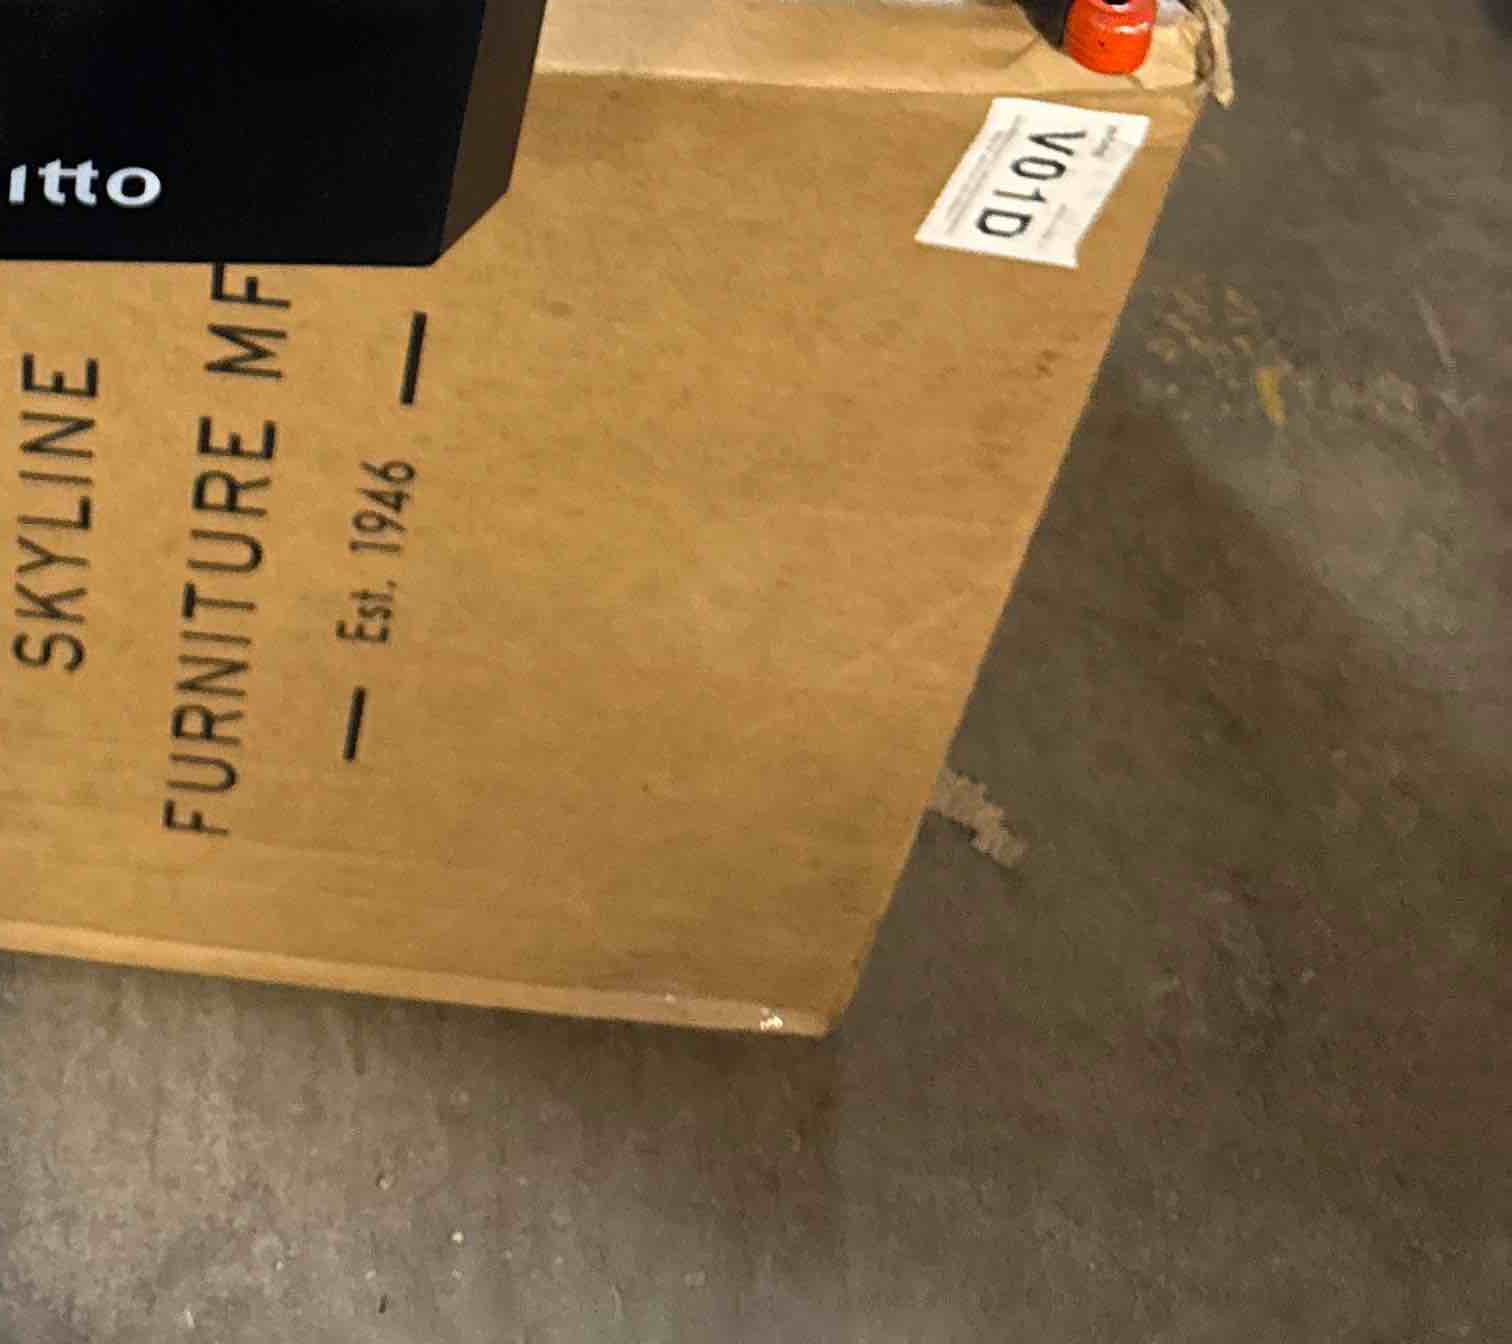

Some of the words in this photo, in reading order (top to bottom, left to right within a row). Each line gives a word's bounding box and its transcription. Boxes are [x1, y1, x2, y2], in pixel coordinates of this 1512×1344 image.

[12, 352, 99, 672] SKYLINE
[351, 459, 416, 558] 1946
[163, 415, 276, 837] FURNITURE
[336, 580, 398, 647] Est.
